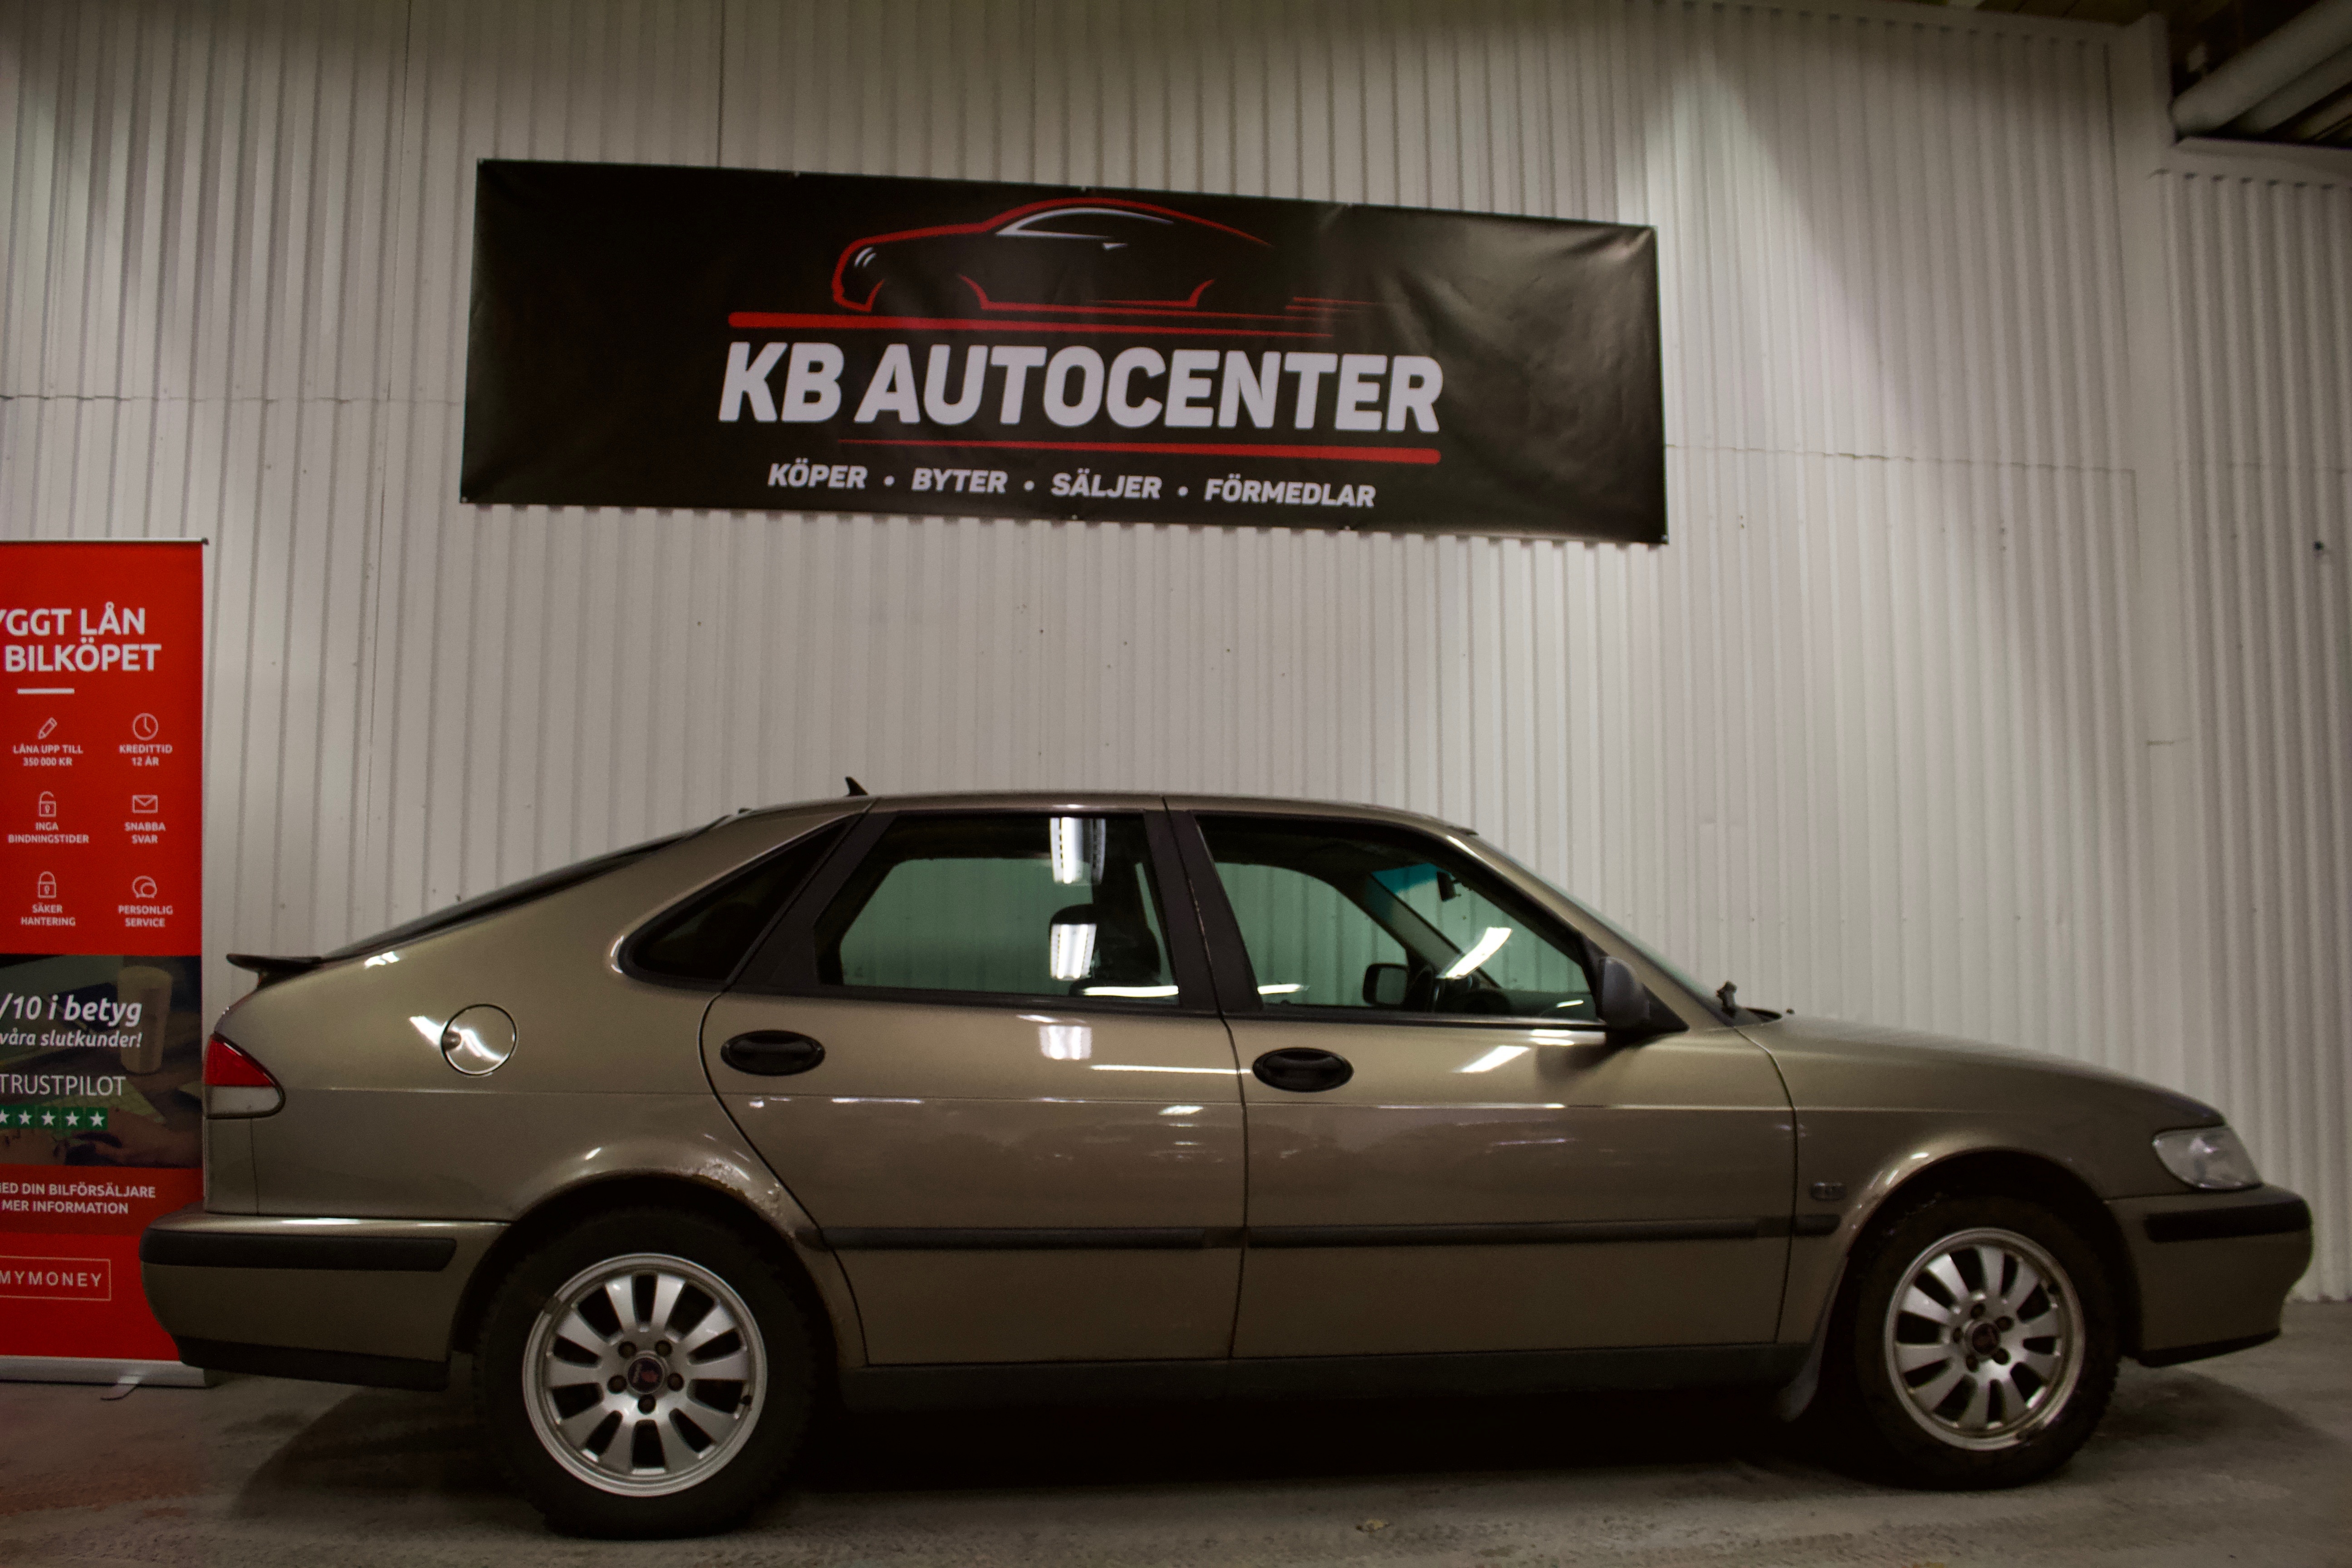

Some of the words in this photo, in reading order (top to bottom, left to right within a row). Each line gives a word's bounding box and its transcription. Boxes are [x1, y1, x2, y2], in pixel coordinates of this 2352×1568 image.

[718, 342, 845, 423] KB
[854, 343, 1444, 433] AUTOCENTER
[767, 458, 868, 490] KÖPER
[911, 467, 1009, 494] BYTER
[1050, 468, 1162, 500] SÄLJER
[1204, 474, 1377, 508] FÖRMEDLAR
[0, 608, 72, 636] GGT
[80, 601, 145, 635] LÅN
[5, 637, 162, 672] BILKÖPET
[13, 744, 39, 754] LÅNA
[41, 745, 60, 754] UPP
[62, 745, 83, 754] TILL
[119, 744, 173, 754] KREDITTID
[23, 757, 39, 766] 350
[40, 757, 57, 766] 000
[58, 757, 72, 766] KR
[132, 757, 142, 766] 12
[144, 755, 159, 766] ÅR
[35, 822, 59, 831] INGA
[124, 822, 166, 831] SNABBA
[8, 834, 89, 843] BINDNINGSTIDER
[132, 834, 158, 844] SVAR
[32, 902, 63, 913] SÄKER
[118, 905, 173, 915] PERSONLIG
[20, 916, 76, 926] HANTERING
[125, 918, 165, 927] SERVICE
[48, 994, 59, 1020] i
[64, 994, 142, 1028] betyg
[0, 1027, 36, 1046] våra
[40, 1029, 143, 1048] slutkunder!
[0, 1073, 126, 1096] TRUSTPILOT
[0, 1182, 19, 1194] ED
[22, 1182, 45, 1195] DIN
[49, 1181, 156, 1198] BILFÖRSÄLJARE
[2, 1199, 29, 1212] MER
[33, 1200, 129, 1214] INFORMATION
